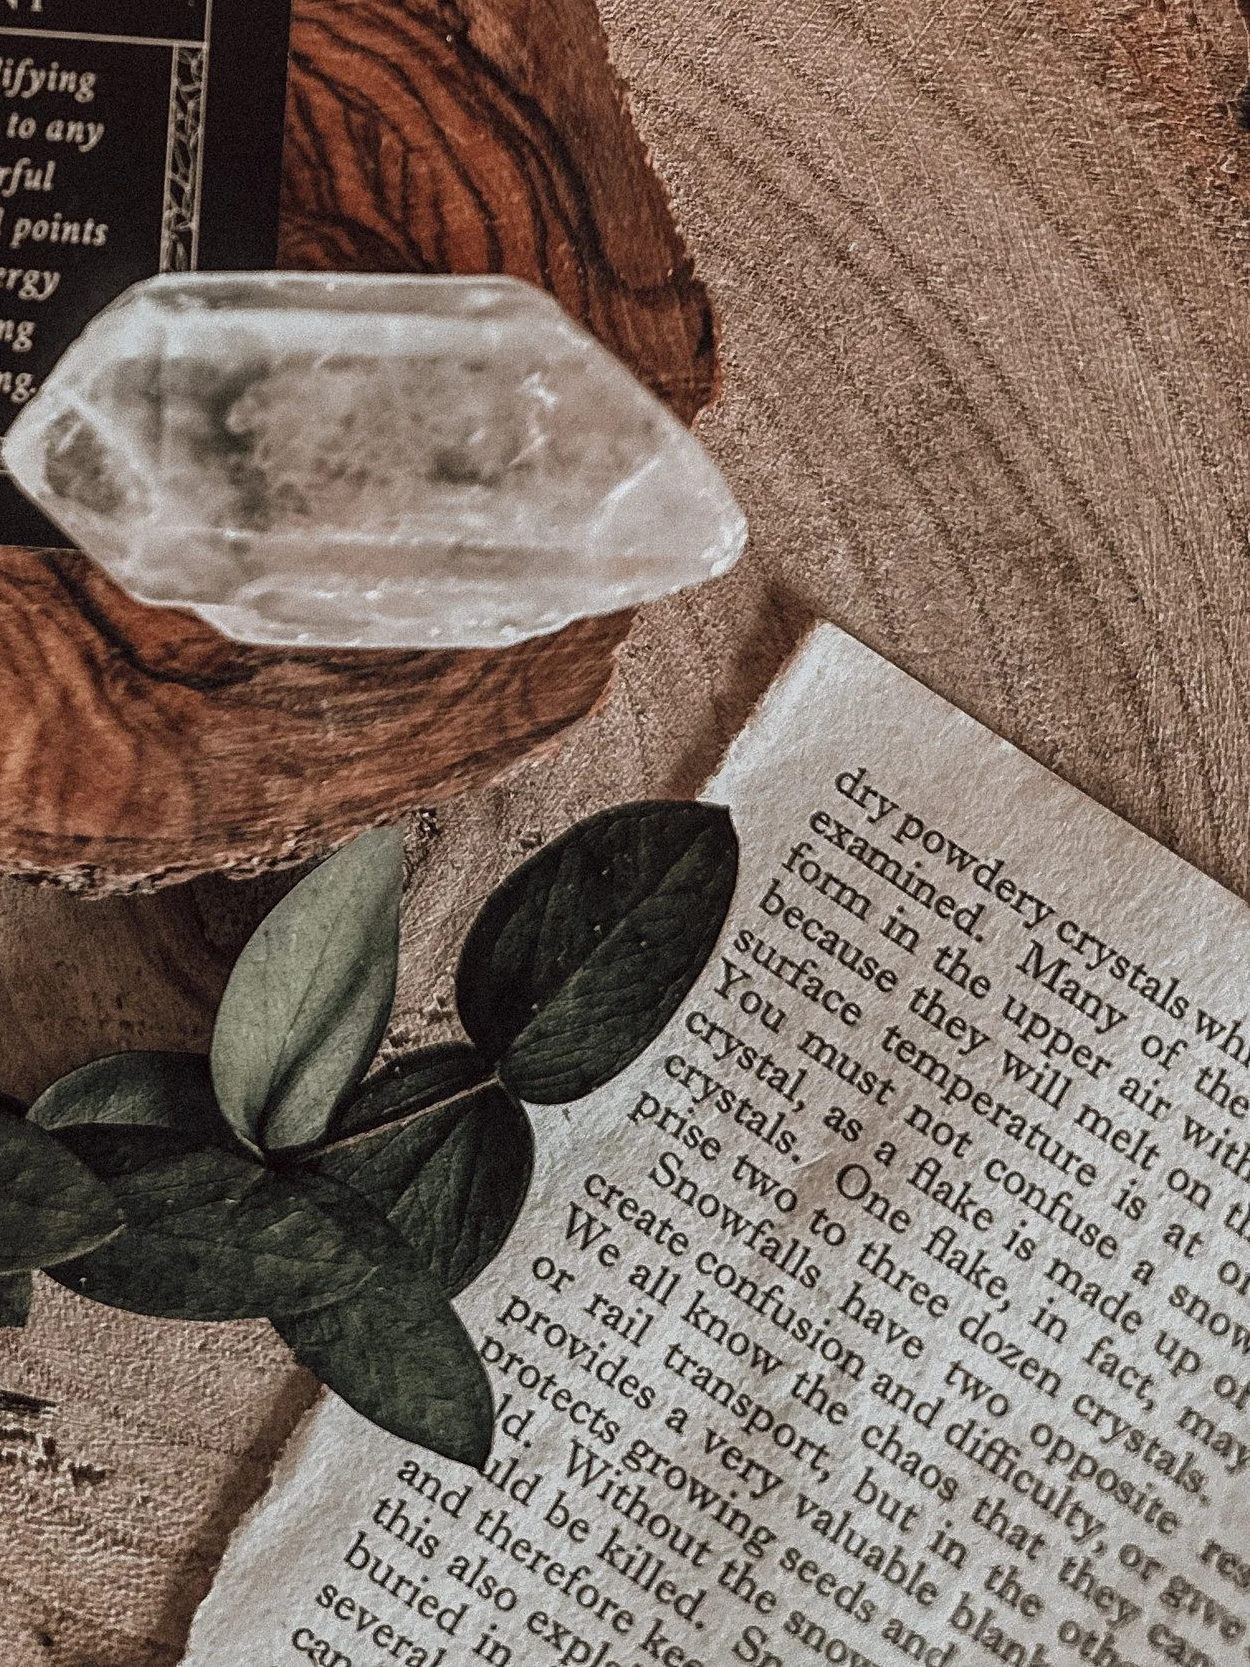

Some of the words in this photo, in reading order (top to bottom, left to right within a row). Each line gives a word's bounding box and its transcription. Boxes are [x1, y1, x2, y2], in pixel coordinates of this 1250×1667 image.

[6, 112, 36, 139] to
[45, 119, 105, 153] any
[9, 211, 108, 248] points
[758, 876, 899, 996] because
[908, 986, 992, 1057] they
[1001, 1047, 1073, 1112] will
[1072, 1102, 1161, 1172] melt
[1165, 1167, 1212, 1212] on
[780, 841, 873, 923] form
[878, 904, 920, 955] in
[932, 944, 991, 1000] the
[1000, 993, 1113, 1080] upper
[1117, 1076, 1172, 1121] air
[808, 810, 987, 944] examined.
[1014, 938, 1129, 1035] Many
[1139, 1033, 1189, 1072] of
[834, 766, 901, 825] dry
[890, 812, 1058, 931] powdery
[1055, 919, 1190, 1021] crystals
[662, 1054, 800, 1164] crystals.
[835, 1162, 912, 1235] One
[920, 1224, 1012, 1314] flake,
[1027, 1295, 1069, 1345] in
[1080, 1334, 1156, 1414] fact,
[684, 1010, 808, 1114] crystal,
[821, 1105, 864, 1143] as
[872, 1140, 898, 1168] a
[905, 1156, 994, 1233] flake
[1001, 1218, 1038, 1262] is
[1042, 1256, 1144, 1335] made
[1153, 1329, 1203, 1379] up
[713, 956, 788, 1035] You
[796, 1029, 896, 1107] must
[903, 1103, 974, 1159] not
[983, 1157, 1119, 1260] confuse
[1130, 1259, 1156, 1287] a
[732, 928, 863, 1029] surface
[880, 1024, 1097, 1188] temperature
[1110, 1177, 1148, 1222] is
[1161, 1222, 1204, 1260] at
[530, 1255, 576, 1294] or
[581, 1292, 655, 1348] rail
[662, 1341, 831, 1485] transport,
[851, 1465, 920, 1535] but
[925, 1519, 968, 1571] in
[983, 1563, 1044, 1620] the
[564, 1200, 621, 1270] We
[627, 1263, 682, 1309] all
[679, 1288, 787, 1377] know
[789, 1370, 849, 1426] the
[860, 1420, 959, 1505] chaos
[970, 1495, 1046, 1562] that
[1057, 1555, 1142, 1630] they
[582, 1173, 689, 1258] create
[694, 1250, 866, 1382] confusion
[869, 1372, 946, 1431] and
[943, 1417, 1108, 1558] difficulty,
[1118, 1543, 1165, 1583] or
[625, 1089, 722, 1162] prise
[731, 1153, 798, 1217] two
[808, 1207, 847, 1247] to
[855, 1240, 949, 1320] three
[957, 1310, 1063, 1400] dozen
[1071, 1393, 1209, 1506] crystals.
[646, 1150, 822, 1290] Snowfalls
[836, 1279, 925, 1360] have
[942, 1359, 1012, 1419] two
[1028, 1422, 1180, 1536] opposite
[342, 1529, 470, 1638] buried
[371, 1497, 441, 1560] this
[445, 1554, 519, 1613] also
[395, 1459, 474, 1520] and
[473, 1508, 635, 1636] therefore
[479, 1334, 621, 1446] protects
[619, 1437, 777, 1561] growing
[778, 1546, 877, 1626] seeds
[494, 1293, 656, 1411] provides
[663, 1406, 689, 1437] a
[703, 1426, 785, 1501] very
[795, 1491, 939, 1609] valuable
[542, 1489, 590, 1544] be
[594, 1524, 708, 1631] killed.
[565, 1434, 714, 1569] Without
[716, 1558, 777, 1616] the
